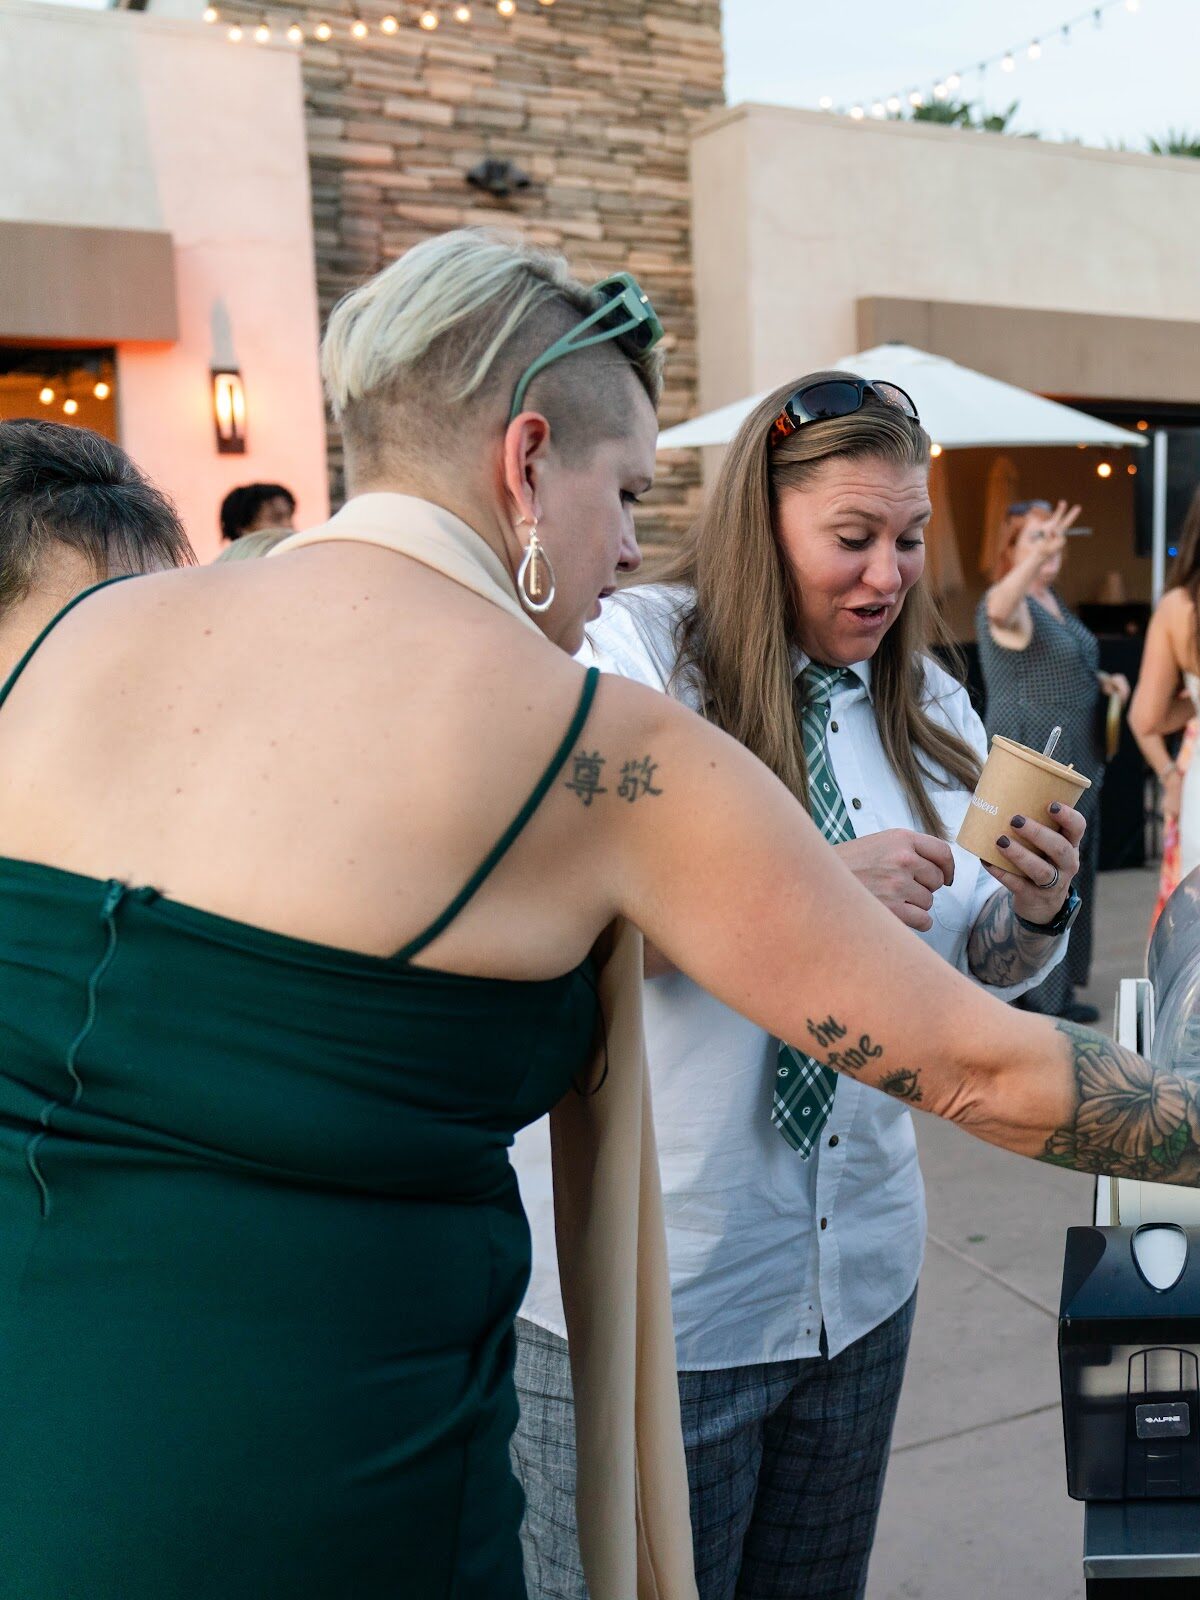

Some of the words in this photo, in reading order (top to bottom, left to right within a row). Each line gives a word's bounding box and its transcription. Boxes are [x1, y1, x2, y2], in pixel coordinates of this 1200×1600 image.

[565, 750, 663, 806] 尊敬
[778, 1067, 789, 1077] G
[802, 1106, 811, 1116] G
[1152, 1415, 1181, 1423] ALPINE
